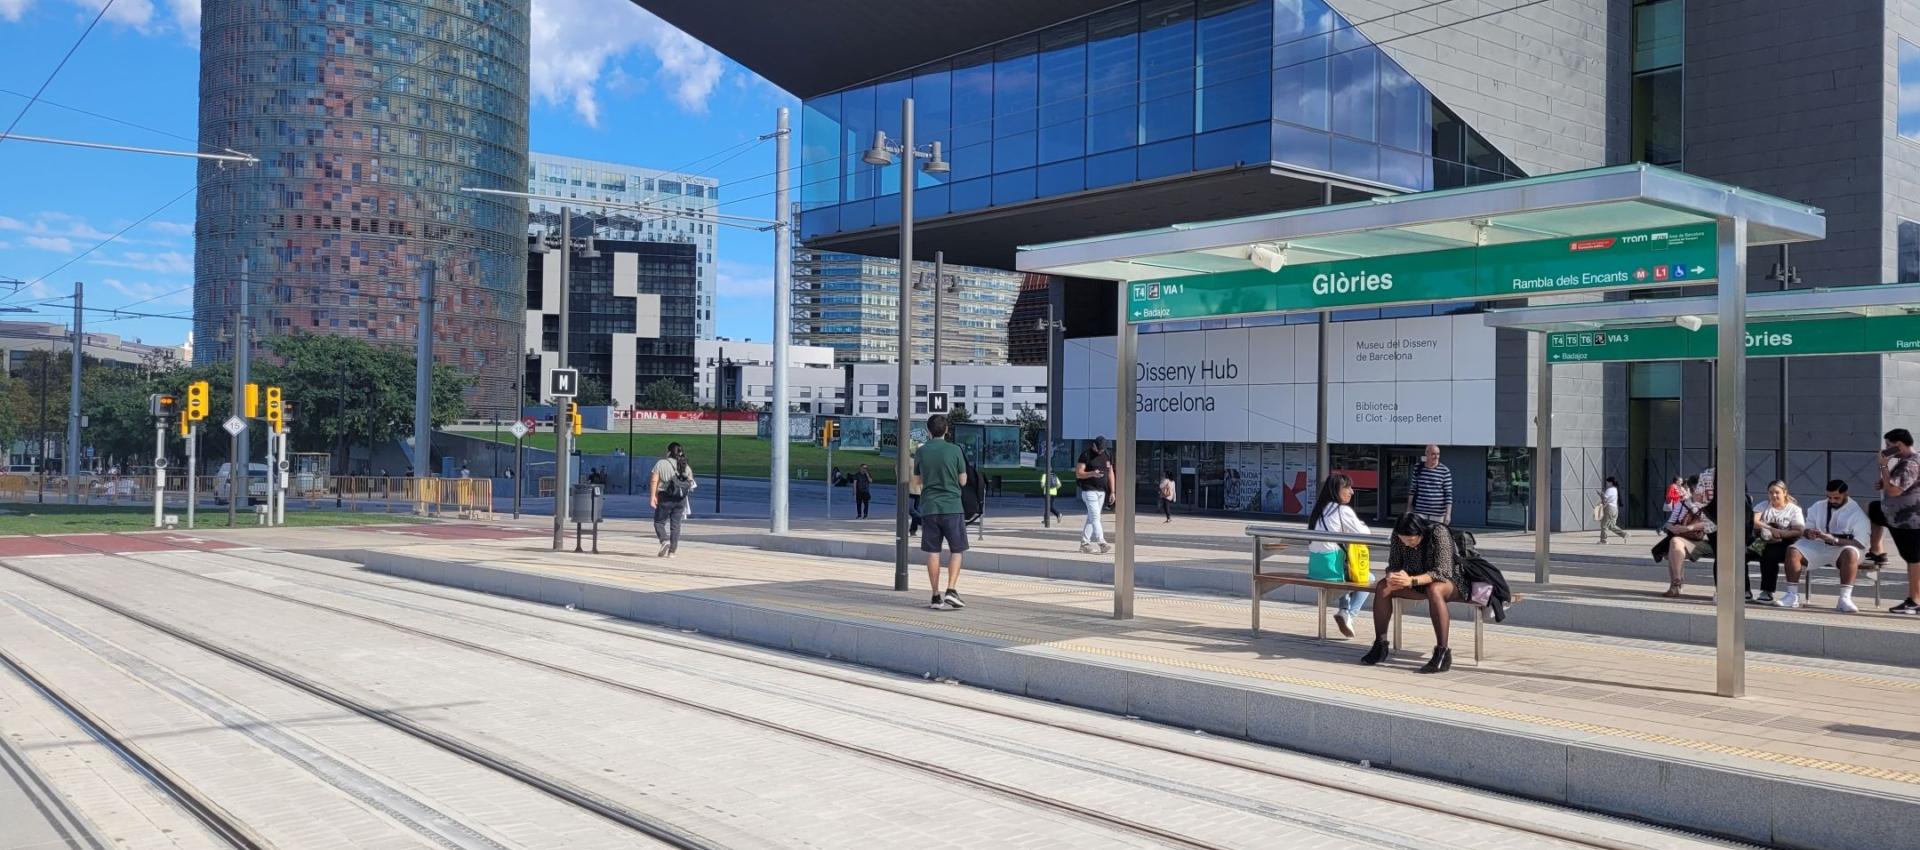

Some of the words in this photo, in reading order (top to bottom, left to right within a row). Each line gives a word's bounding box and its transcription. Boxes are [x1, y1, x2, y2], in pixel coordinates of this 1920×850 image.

[1655, 267, 1666, 277] L1
[1312, 270, 1393, 295] Glòries
[1513, 276, 1553, 289] Rambla
[1556, 274, 1579, 286] dels
[1582, 271, 1629, 284] Encants
[1135, 287, 1145, 298] T4
[1163, 284, 1177, 295] VIA
[1143, 307, 1170, 318] Badajoz
[1356, 340, 1385, 350] Museu
[1387, 338, 1400, 349] del
[1402, 338, 1438, 350] Disseny
[1553, 337, 1563, 345] T4
[1567, 336, 1577, 344] T5
[1581, 336, 1591, 344] T6
[1608, 335, 1622, 343] VIA
[1623, 334, 1629, 342] 3
[1745, 331, 1793, 347] òries
[1356, 352, 1367, 361] de
[1369, 351, 1413, 361] Barcelona
[1562, 352, 1588, 360] Badajoz
[1136, 361, 1196, 384] Disseny
[1201, 357, 1238, 380] Hub
[559, 374, 568, 391] M
[934, 396, 942, 409] M
[1136, 391, 1215, 413] Barcelona
[1356, 401, 1398, 411] Biblioteca
[1356, 413, 1363, 422] El
[1365, 413, 1383, 423] Clot
[1389, 413, 1414, 424] Josep
[1416, 413, 1442, 423] Benet
[230, 422, 240, 430] 15
